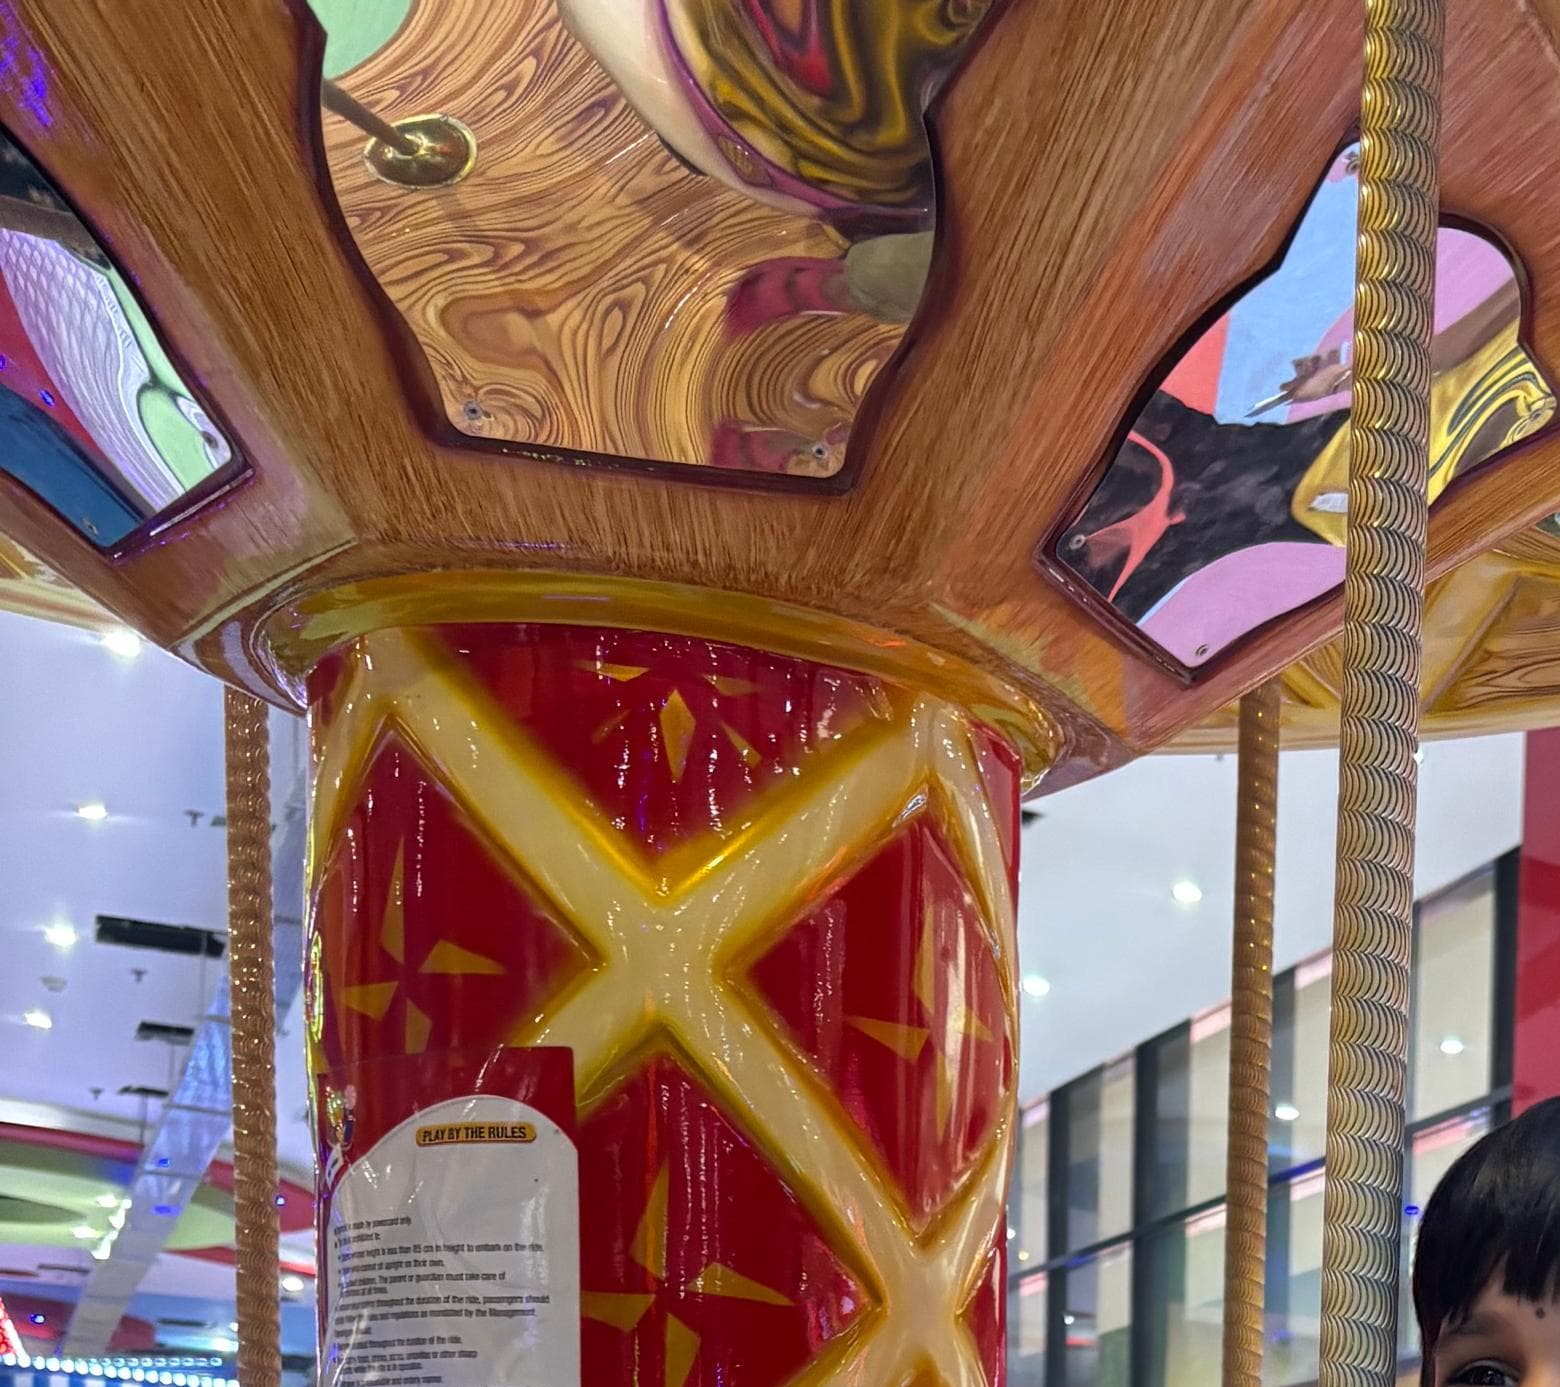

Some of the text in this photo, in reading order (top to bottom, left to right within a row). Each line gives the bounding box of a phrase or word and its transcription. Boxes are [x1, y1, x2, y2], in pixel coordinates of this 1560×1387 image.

[422, 1126, 527, 1142] PLAY BY THE RULES
